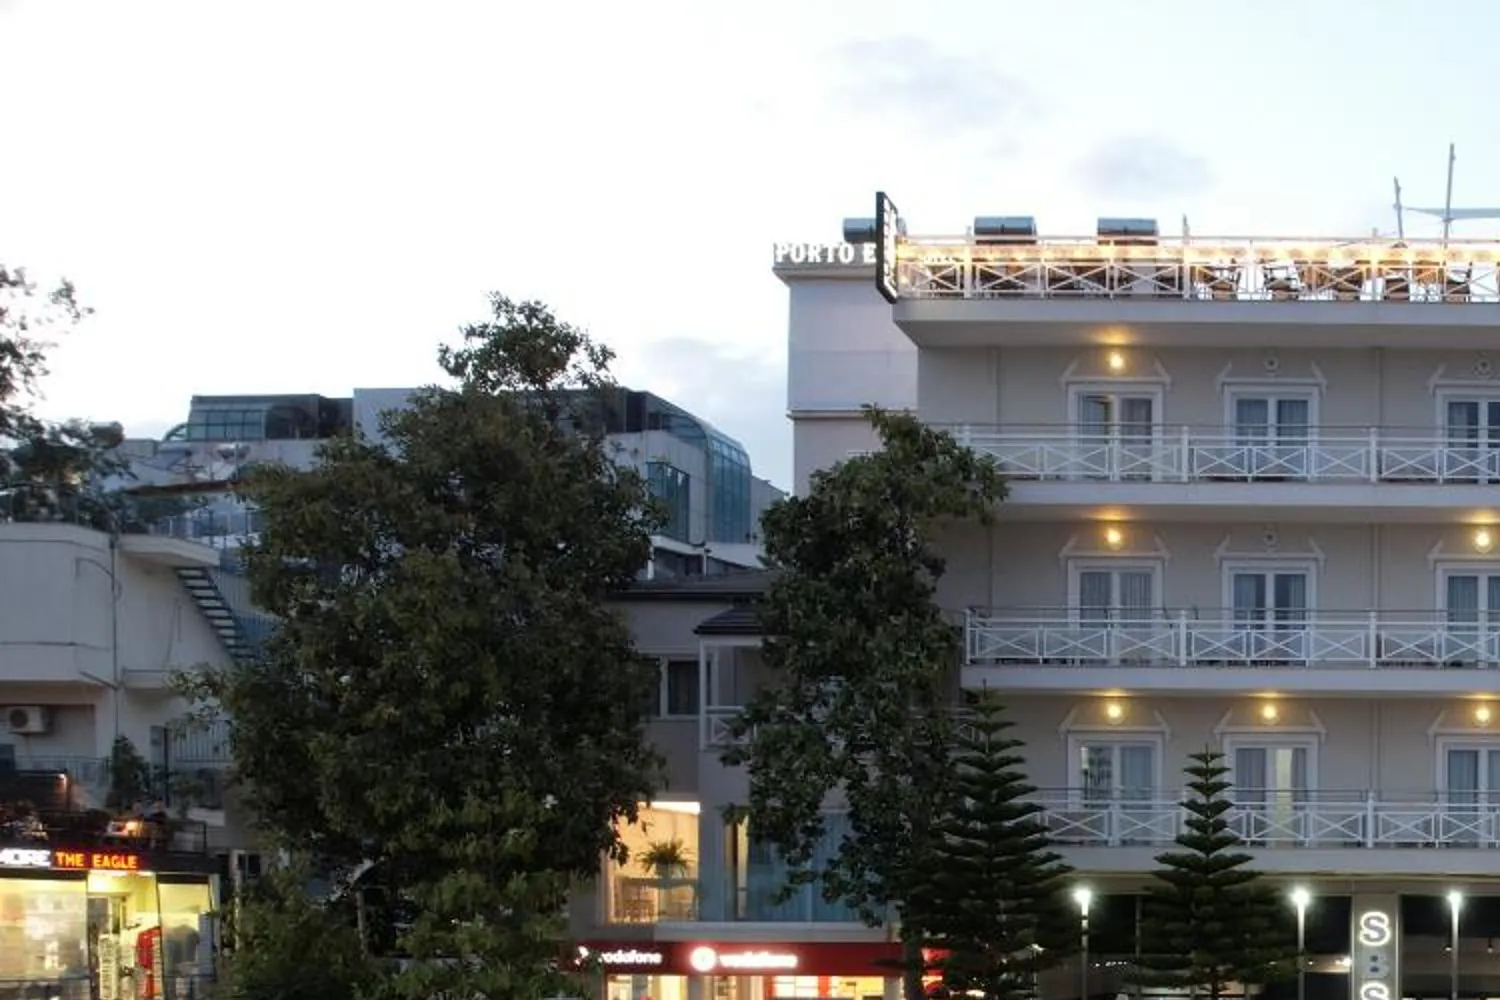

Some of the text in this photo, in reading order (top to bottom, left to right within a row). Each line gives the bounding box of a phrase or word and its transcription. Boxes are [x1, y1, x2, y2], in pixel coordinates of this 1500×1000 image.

[775, 242, 854, 263] PORTO
[55, 851, 138, 869] THE EAGLE
